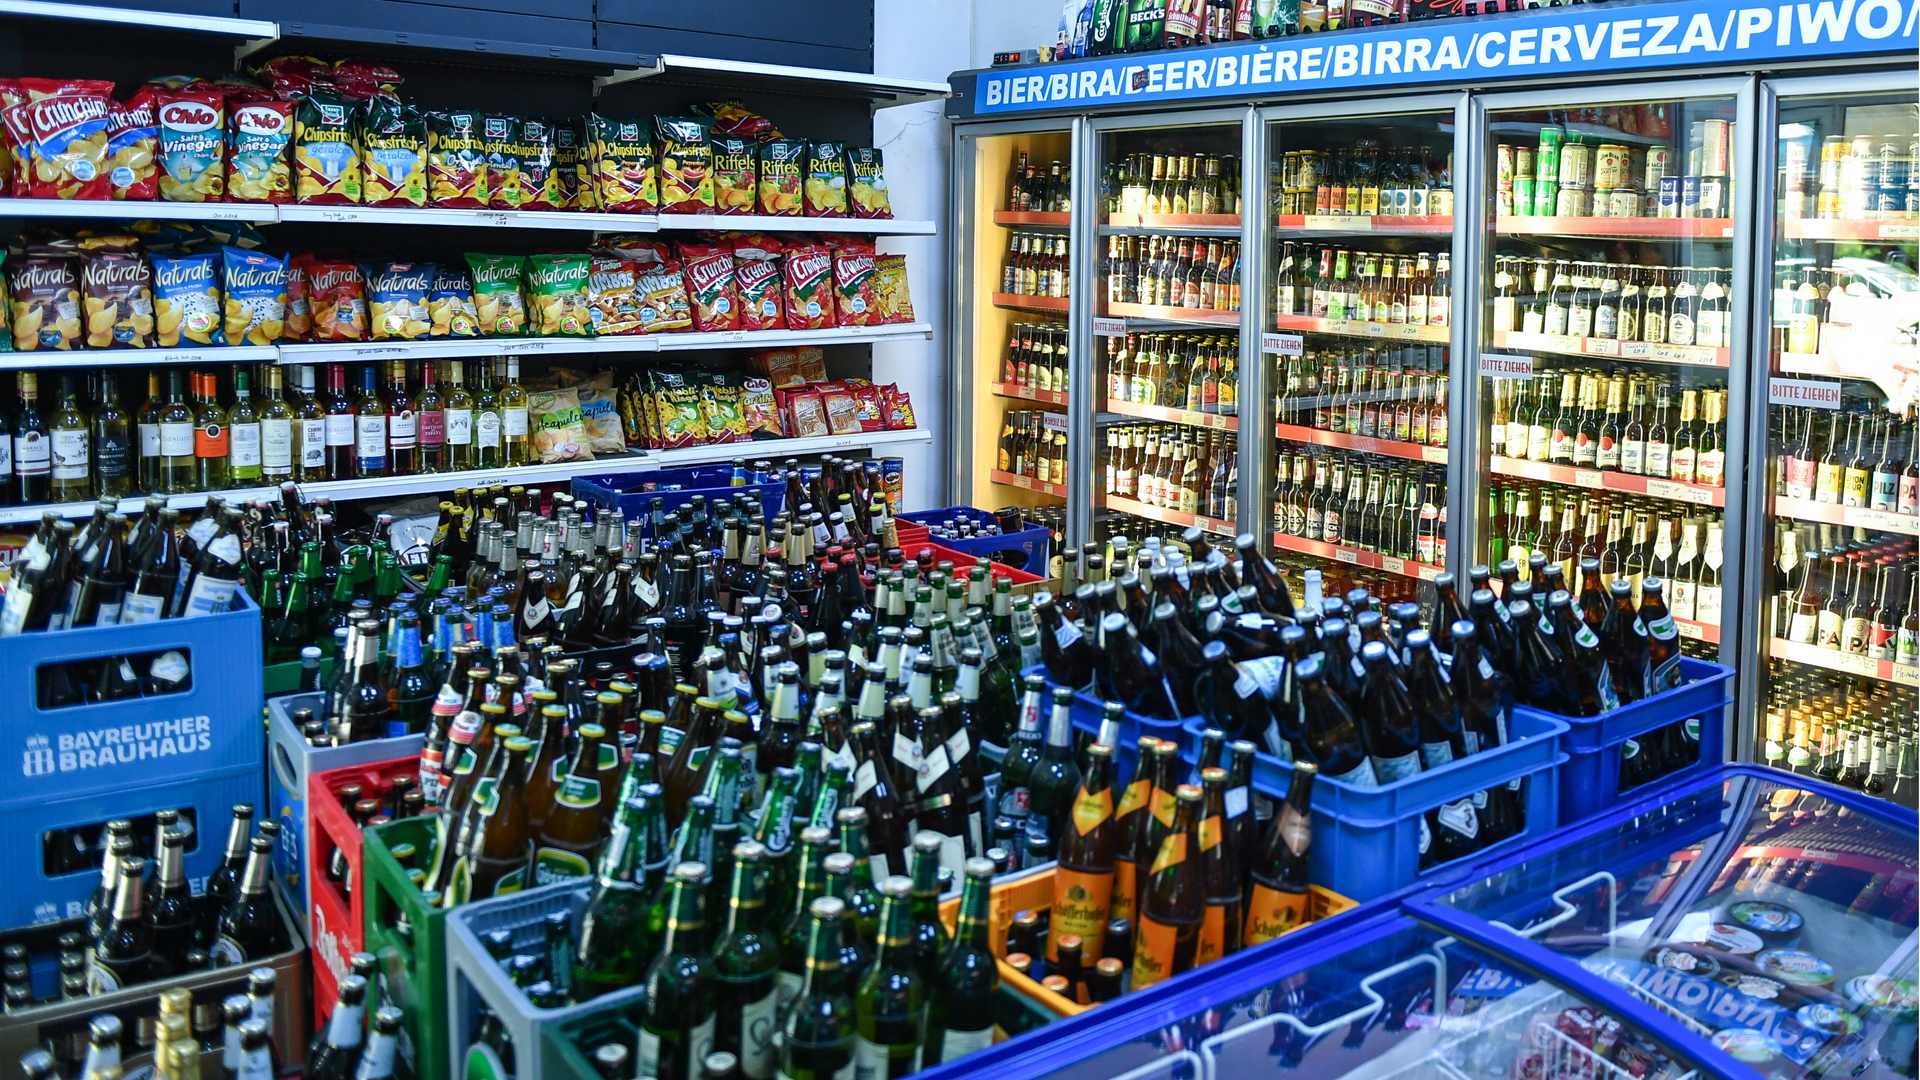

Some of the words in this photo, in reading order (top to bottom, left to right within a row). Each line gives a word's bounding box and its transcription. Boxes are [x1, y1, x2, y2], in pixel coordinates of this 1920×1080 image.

[1130, 8, 1165, 23] BECK'S
[1359, 2, 1385, 11] PILSENER
[1095, 0, 1109, 42] Carlsber
[34, 97, 108, 132] Crunchips
[108, 109, 154, 133] unchips
[165, 107, 215, 125] Chio
[304, 126, 351, 144] Chipsfris
[164, 139, 220, 153] Vinegar
[238, 142, 285, 154] Vinegar
[311, 145, 351, 156] gesalzen
[607, 143, 652, 157] Chipsfrisch
[715, 154, 755, 170] Riffels
[762, 159, 800, 176] Riffels
[83, 258, 150, 289] Naturals
[226, 263, 289, 288] Naturals
[472, 263, 521, 284] Naturals
[541, 262, 589, 285] Naturals
[793, 254, 831, 279] Crunchips
[838, 255, 875, 279] Crunchips
[10, 262, 75, 293] Naturals
[310, 267, 363, 292] Naturals
[375, 273, 428, 292] Naturals
[432, 276, 471, 290] aturals
[636, 271, 683, 303] JUMBOS
[1094, 322, 1108, 332] BITTE
[1108, 323, 1125, 333] ZIEHEN
[1263, 338, 1280, 348] BITTE
[1280, 340, 1302, 350] ZIEHEN
[1481, 359, 1502, 371] BITTE
[1504, 361, 1531, 374] ZIEHEN
[1772, 384, 1799, 399] BITTE
[1802, 387, 1839, 401] ZIEHEN
[537, 411, 583, 431] Acapulco
[1846, 474, 1865, 484] LEMON
[1874, 481, 1896, 495] PILZ
[1901, 483, 1917, 499] IPA
[59, 716, 211, 753] BAYREUTHER
[59, 731, 212, 771] BRAUHAUS
[1053, 902, 1106, 921] chöfferhofer
